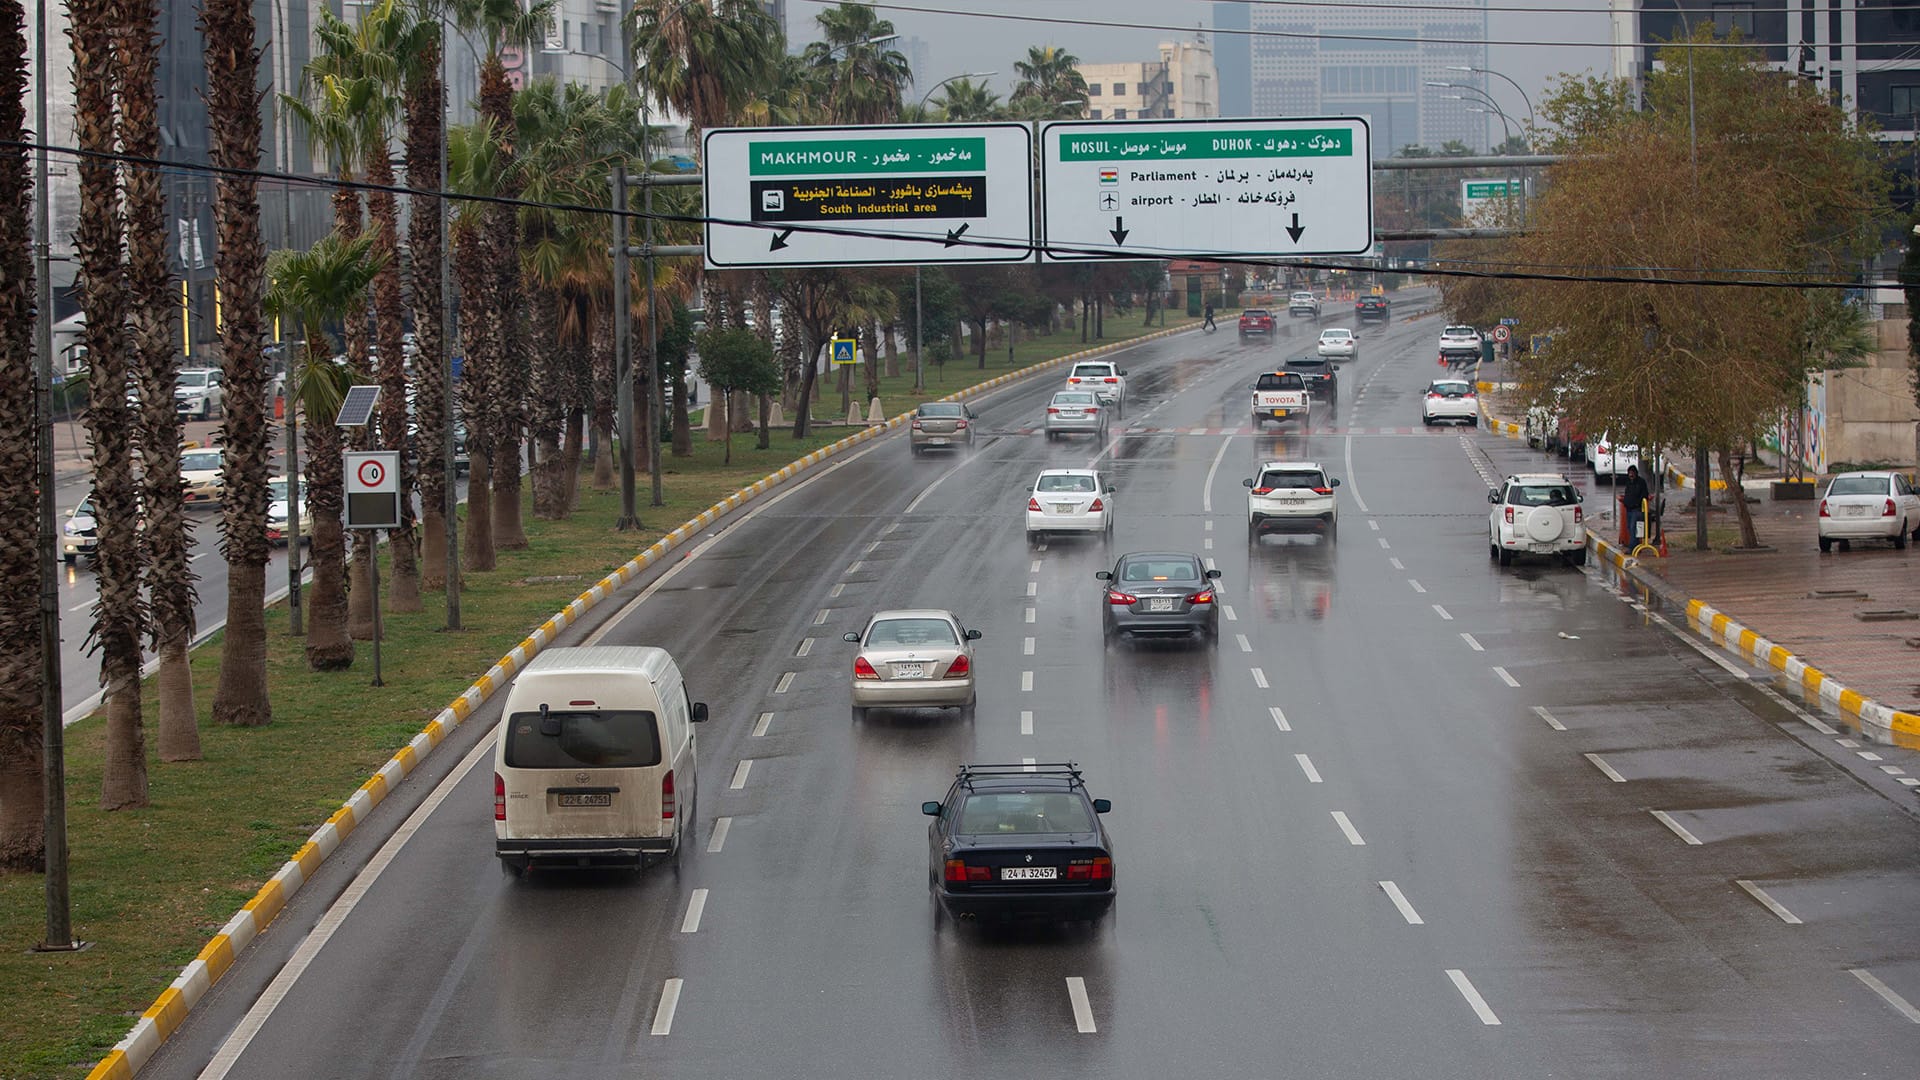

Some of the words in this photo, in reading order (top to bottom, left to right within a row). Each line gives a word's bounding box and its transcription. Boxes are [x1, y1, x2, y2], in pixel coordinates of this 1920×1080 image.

[1071, 141, 1111, 154] MOSUL
[1119, 141, 1150, 156] موصل
[1212, 138, 1253, 151] DUHOK
[761, 150, 857, 165] MAKHMOUR
[872, 148, 911, 166] مخمور
[1130, 170, 1197, 182] Parliament
[1215, 169, 1250, 184] برلمان
[792, 186, 834, 202] الجنوبية
[835, 185, 876, 198] الصناعة
[1131, 195, 1174, 207] airport
[1191, 193, 1221, 208] المطار
[820, 204, 853, 214] South
[857, 202, 909, 214] industrial
[913, 203, 937, 213] area
[1497, 330, 1506, 338] 30
[1264, 396, 1296, 404] TOYOTA
[1007, 868, 1019, 879] 24
[1021, 868, 1027, 878] A
[1029, 868, 1055, 878] 32457
